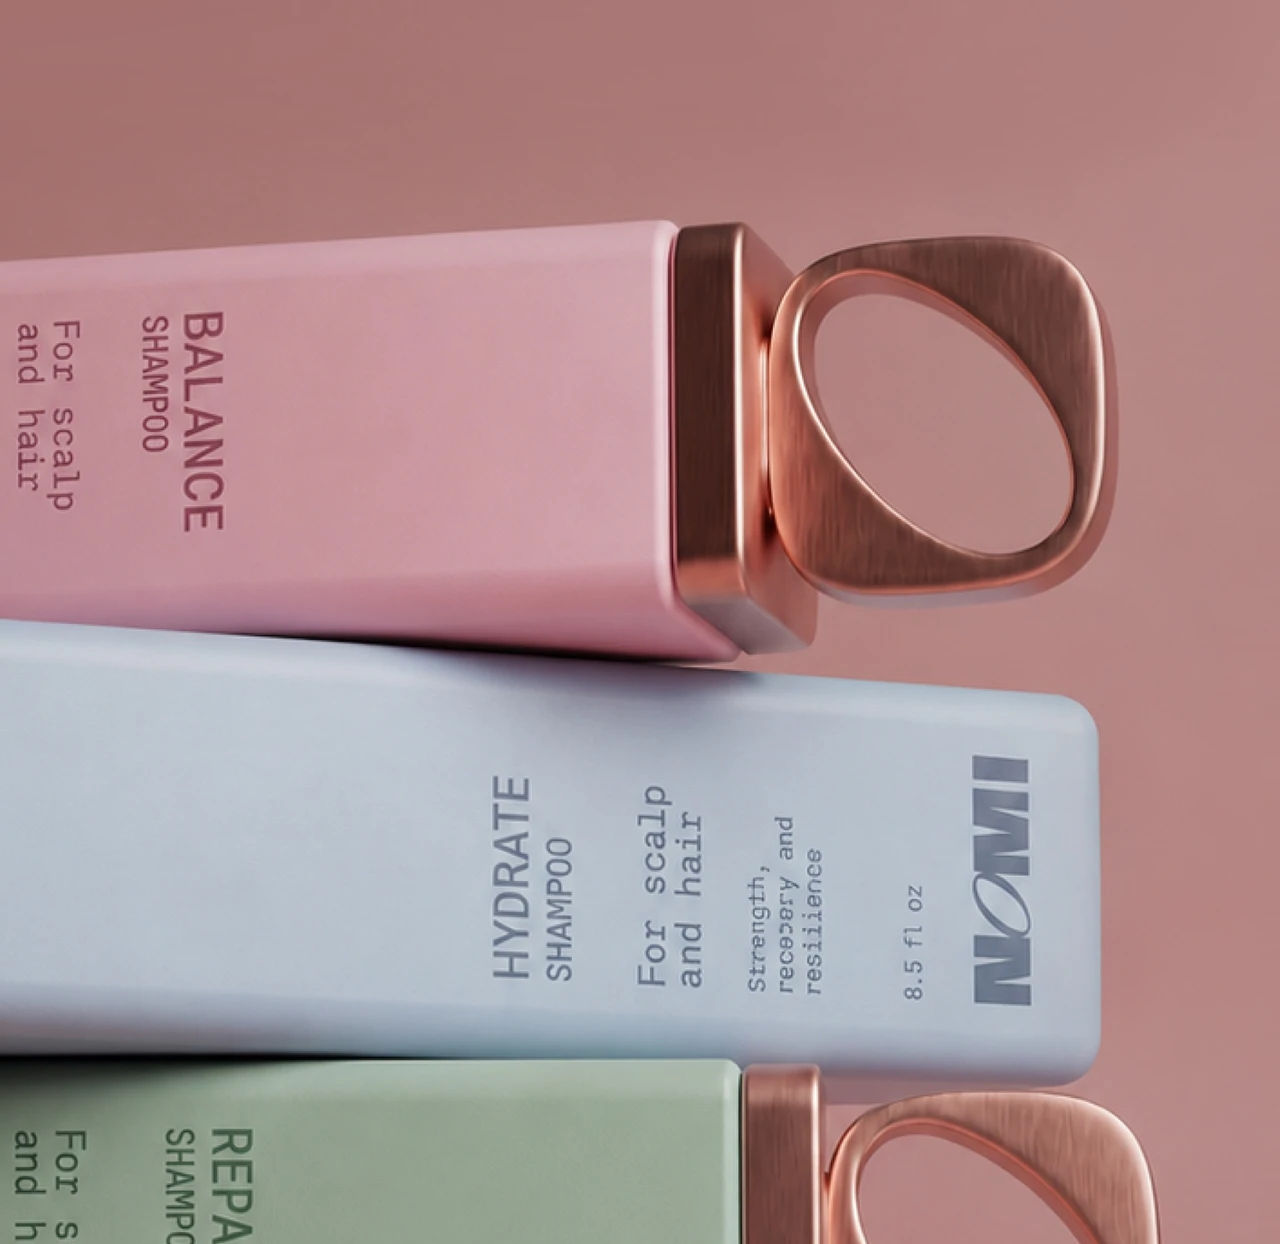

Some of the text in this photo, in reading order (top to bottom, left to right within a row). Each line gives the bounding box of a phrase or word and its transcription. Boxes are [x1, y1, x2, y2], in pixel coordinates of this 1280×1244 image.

[17, 323, 46, 492] and hair
[46, 320, 81, 511] For scalp
[141, 315, 169, 453] SHAMPOO
[183, 311, 225, 533] BALANCE
[492, 775, 530, 979] HYDRATE
[545, 837, 573, 982] SHAMPOO
[637, 786, 673, 987] For scalp
[673, 811, 703, 989] and hair
[773, 816, 794, 861] and
[971, 754, 1032, 1007] NOMI
[902, 885, 924, 1001] 8.5 fl oz
[14, 1130, 48, 1195] and
[55, 1130, 87, 1195] For
